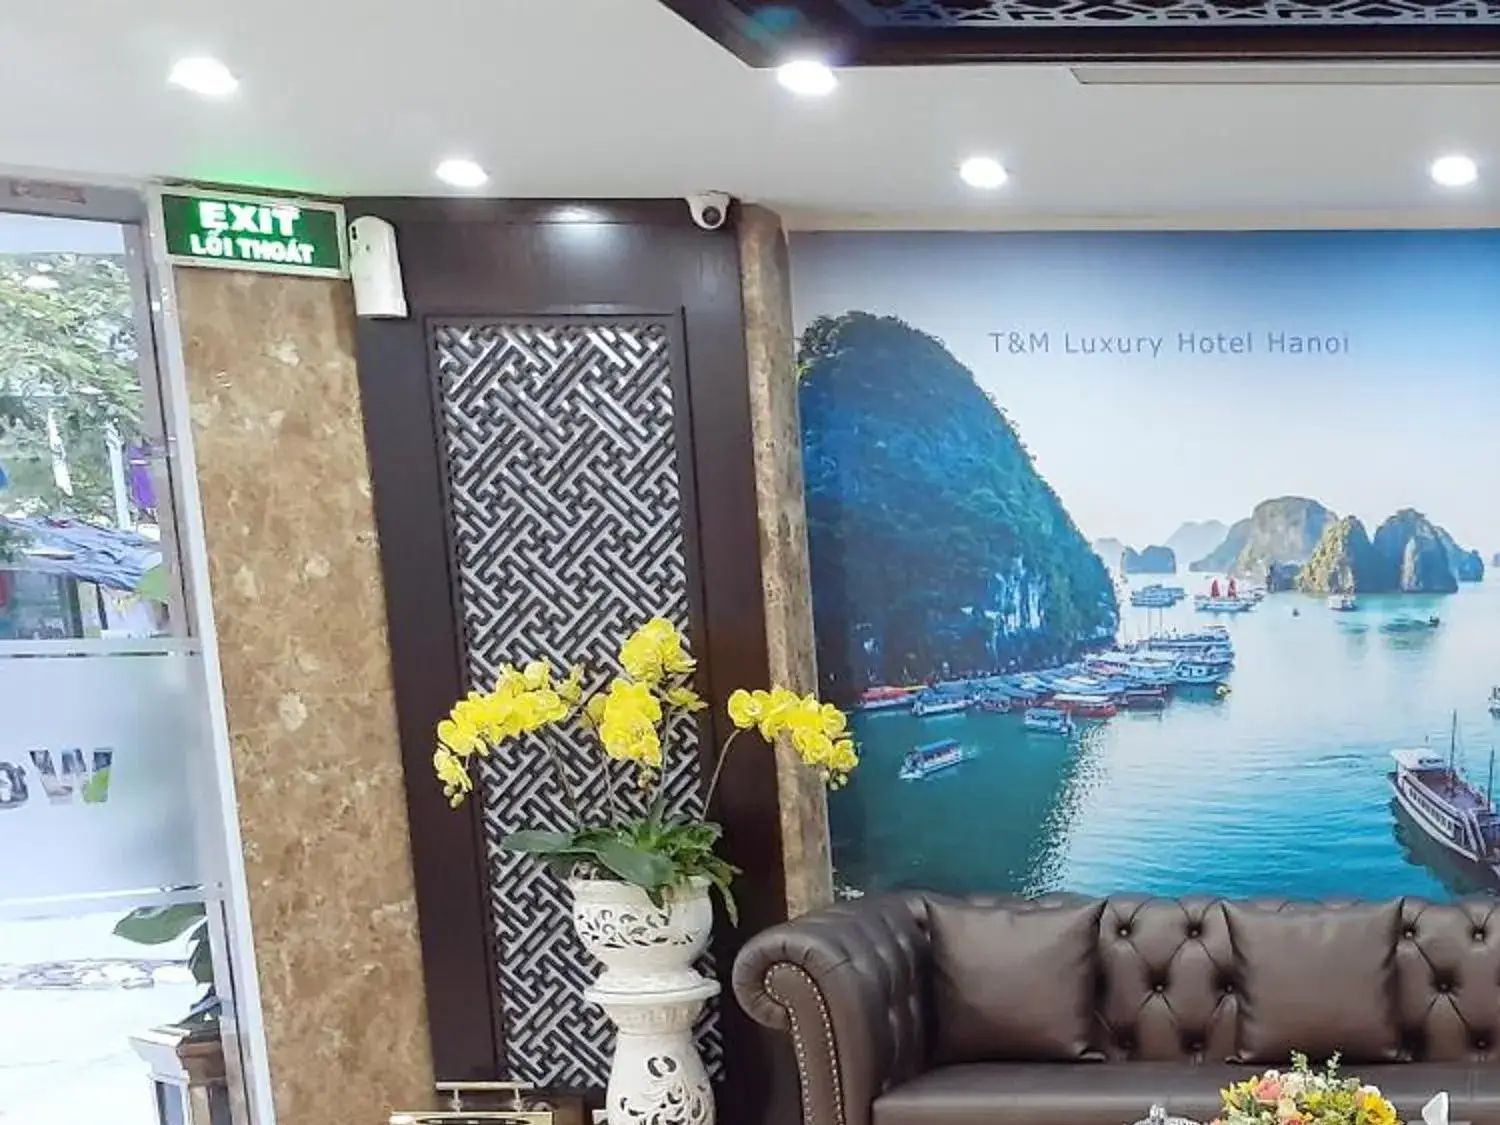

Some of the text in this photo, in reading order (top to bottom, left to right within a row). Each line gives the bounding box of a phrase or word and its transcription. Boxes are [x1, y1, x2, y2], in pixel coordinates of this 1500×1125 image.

[198, 201, 301, 236] EXIT
[189, 227, 315, 264] LỐI THOÁT
[988, 331, 1350, 359] T&M Luxury Hotel Hanoi
